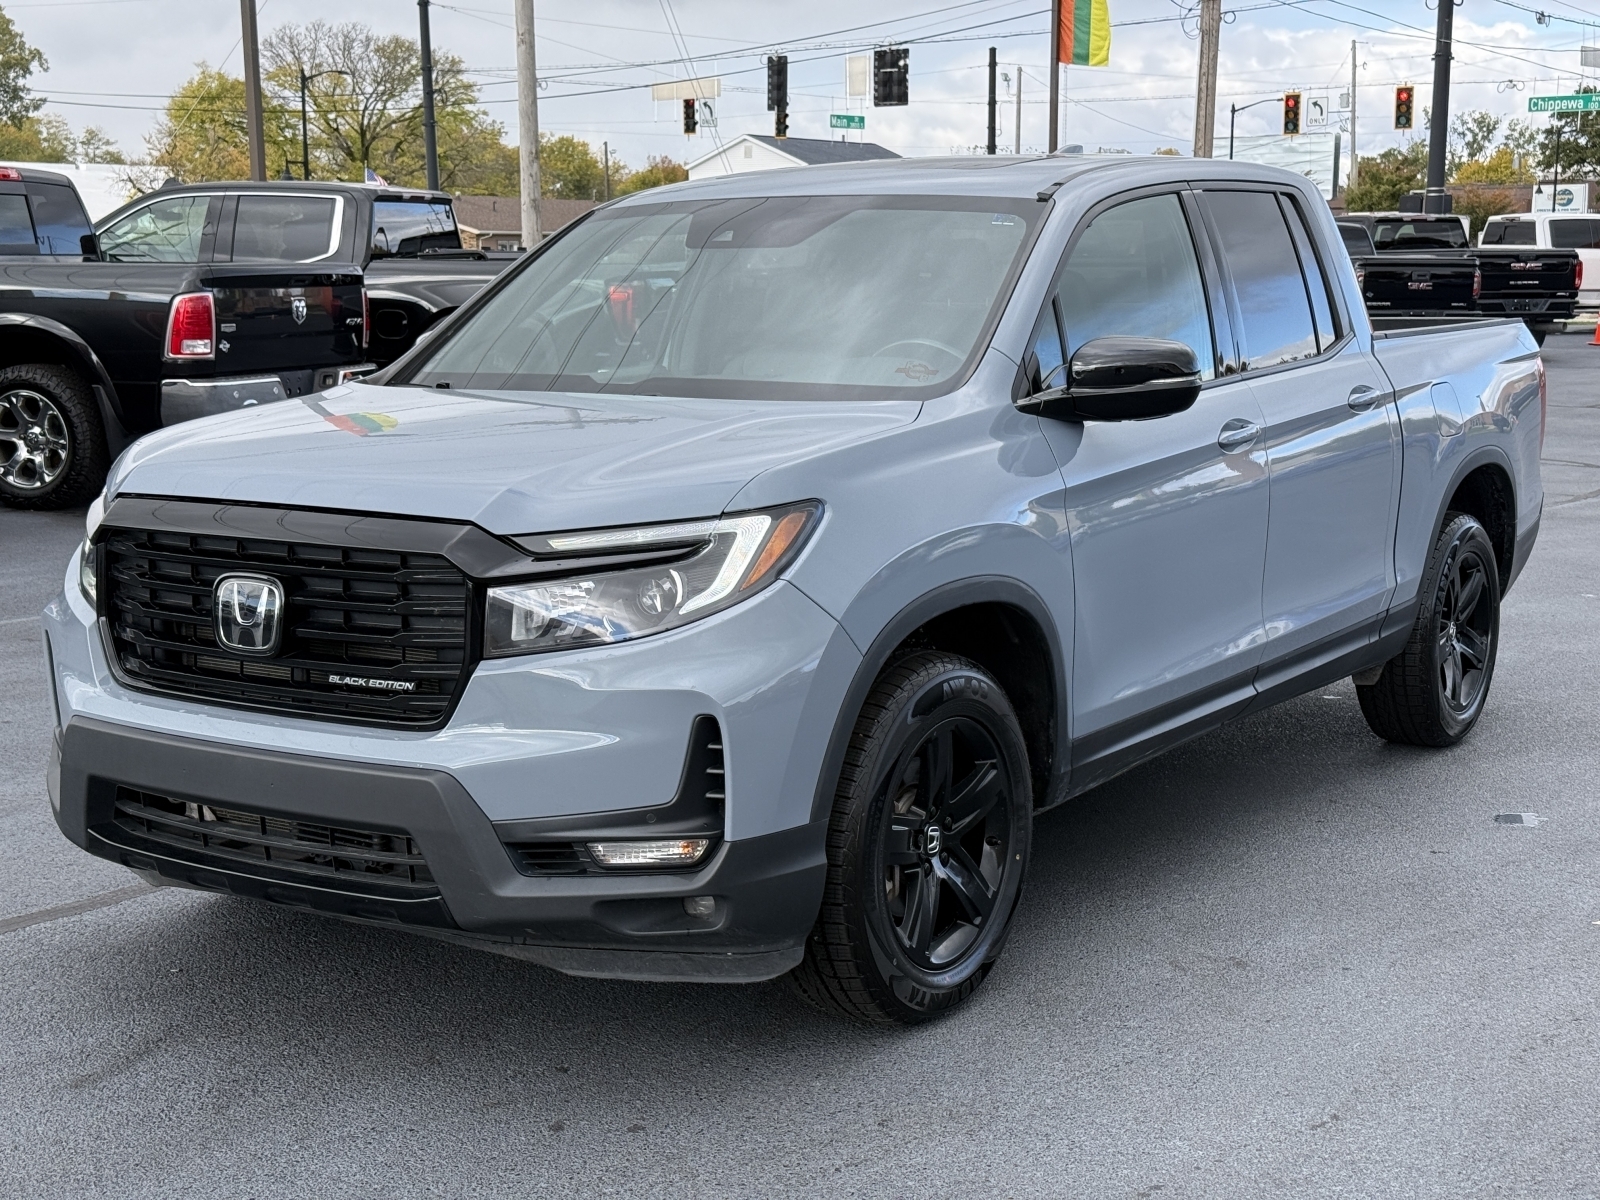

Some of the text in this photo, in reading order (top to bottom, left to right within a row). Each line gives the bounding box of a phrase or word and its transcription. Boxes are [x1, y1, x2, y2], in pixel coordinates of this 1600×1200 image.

[1530, 97, 1584, 111] Chippewa
[1587, 101, 1599, 109] 100
[831, 115, 848, 127] Main
[1510, 262, 1543, 270] GMC
[1408, 282, 1433, 290] GMC
[328, 674, 416, 691] BLACK EDITION
[907, 967, 984, 1010] ADVANTA
